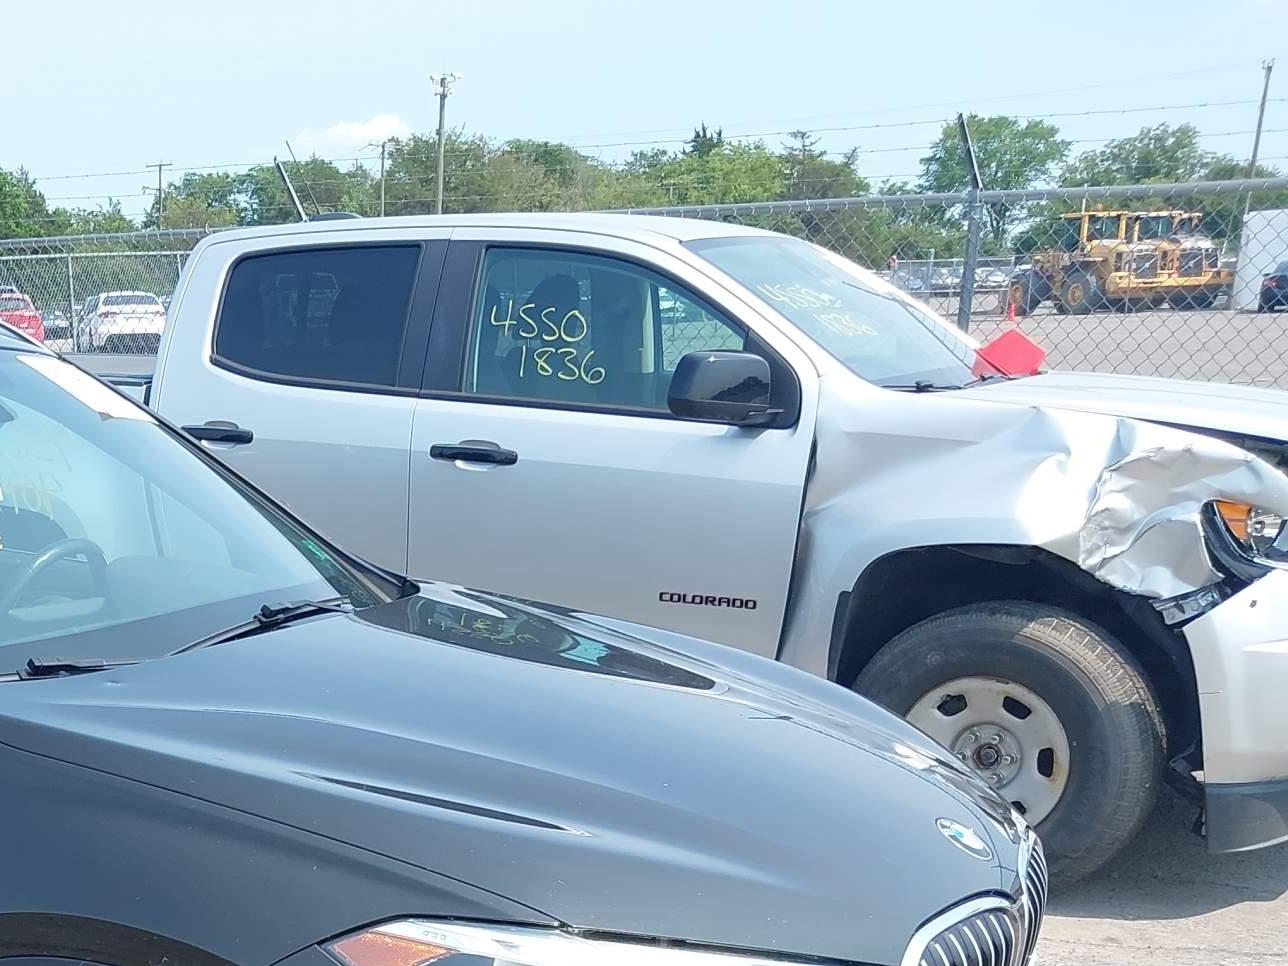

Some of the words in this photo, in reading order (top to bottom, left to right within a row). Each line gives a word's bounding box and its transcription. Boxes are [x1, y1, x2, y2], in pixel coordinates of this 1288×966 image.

[490, 299, 588, 342] 4550
[519, 345, 606, 384] 1836
[658, 591, 758, 610] COLORADO
